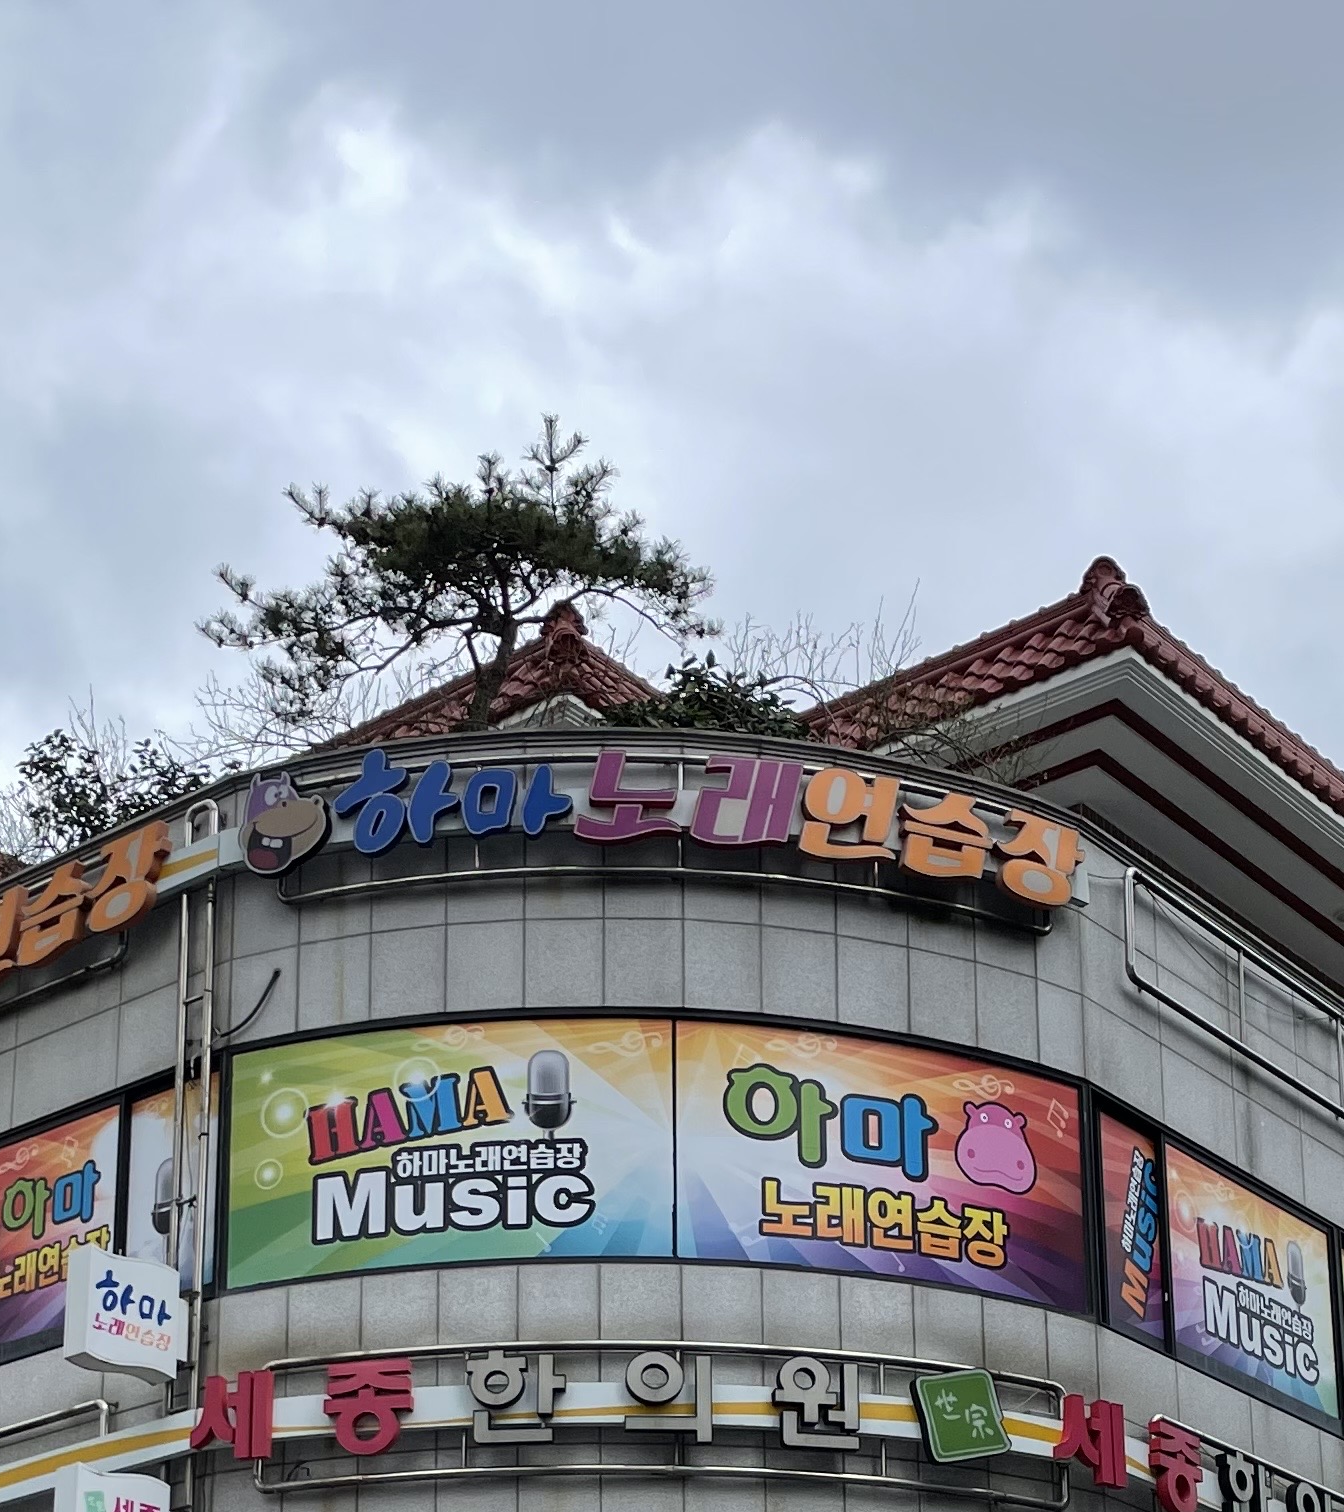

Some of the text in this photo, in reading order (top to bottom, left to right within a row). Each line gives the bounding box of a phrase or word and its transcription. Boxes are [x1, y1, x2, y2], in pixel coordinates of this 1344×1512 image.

[307, 1065, 510, 1163] HAMA
[392, 1139, 587, 1177] 하마노래연습장
[759, 1176, 1009, 1271] 노래연습장
[1196, 1216, 1282, 1289] HAMA
[96, 1270, 172, 1326] 하마
[1237, 1283, 1314, 1343] 하마노래연습장
[93, 1313, 172, 1351] 노래연습장
[190, 1351, 861, 1462] 세종한의원
